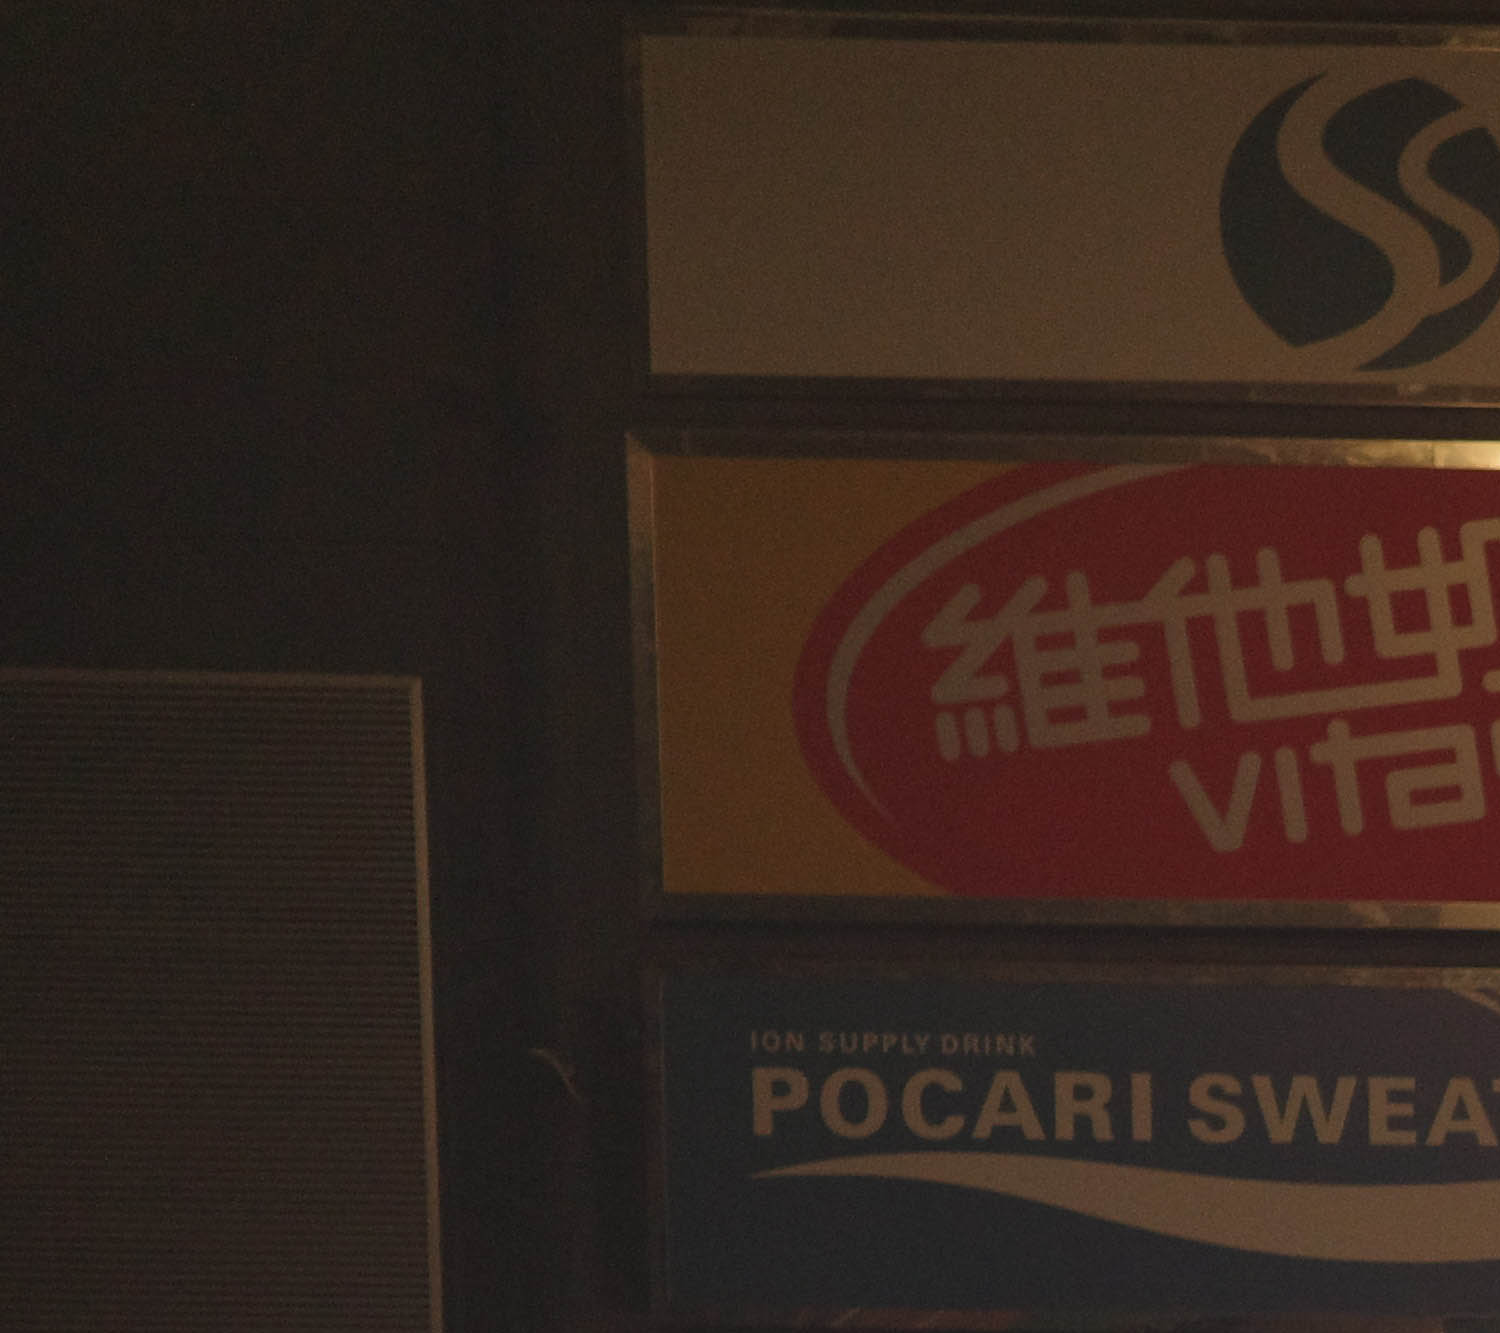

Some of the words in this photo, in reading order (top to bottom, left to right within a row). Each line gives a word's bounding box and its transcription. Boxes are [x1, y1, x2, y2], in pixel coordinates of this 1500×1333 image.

[750, 1030, 805, 1055] ION
[818, 1031, 931, 1056] SUPPLY
[941, 1033, 1037, 1057] DRINK
[752, 1066, 1153, 1143] POCARI
